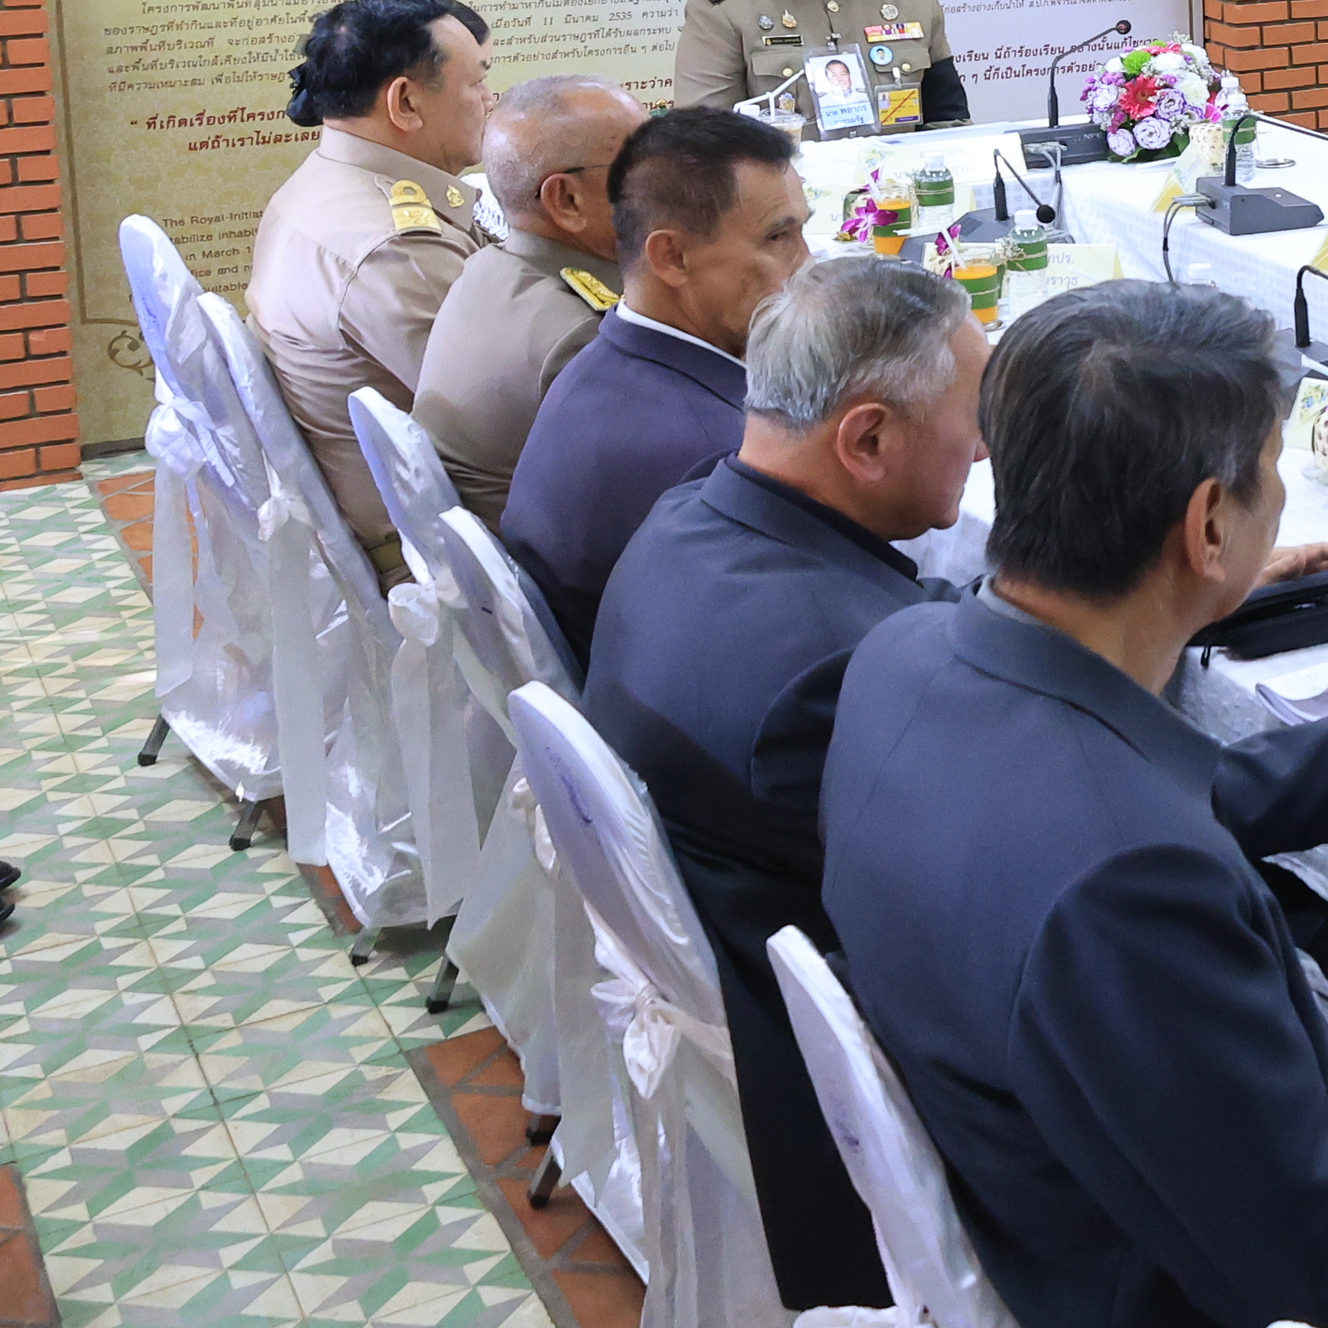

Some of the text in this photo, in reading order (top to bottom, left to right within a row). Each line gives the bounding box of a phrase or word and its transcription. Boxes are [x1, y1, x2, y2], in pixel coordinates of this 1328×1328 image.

[564, 14, 599, 24] มีนาคม
[608, 11, 633, 22] 2535
[641, 8, 679, 19] ความว่า
[983, 62, 1102, 81] นี้ก็เป็นโครงการตัวอย่า
[146, 107, 286, 130] ที่เกิดเรื่องที่โครงก
[162, 210, 263, 228] The Royal-Initiat
[202, 246, 240, 260] March
